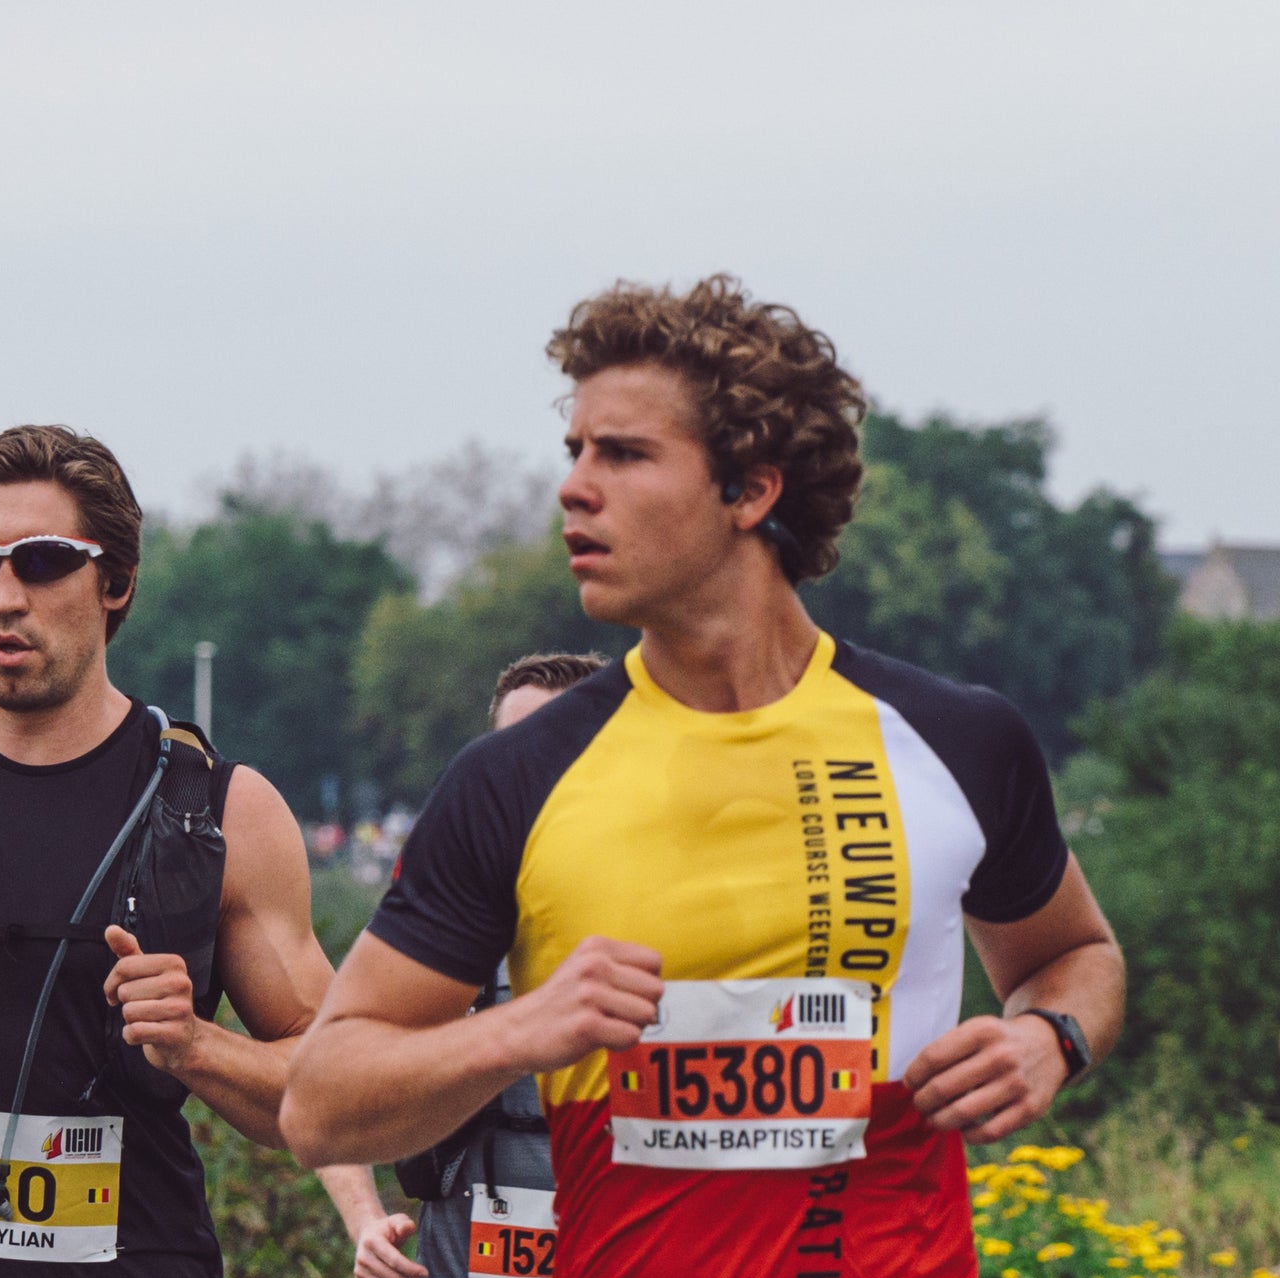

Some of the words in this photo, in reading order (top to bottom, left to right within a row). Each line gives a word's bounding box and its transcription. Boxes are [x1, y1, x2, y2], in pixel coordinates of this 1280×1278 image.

[793, 760, 820, 805] LONG
[801, 813, 829, 884] COURSE
[825, 760, 897, 1071] NIEUWPO
[649, 1044, 826, 1116] 15380
[644, 1128, 836, 1150] JEAN-BAPTISTE
[499, 1229, 557, 1276] 152
